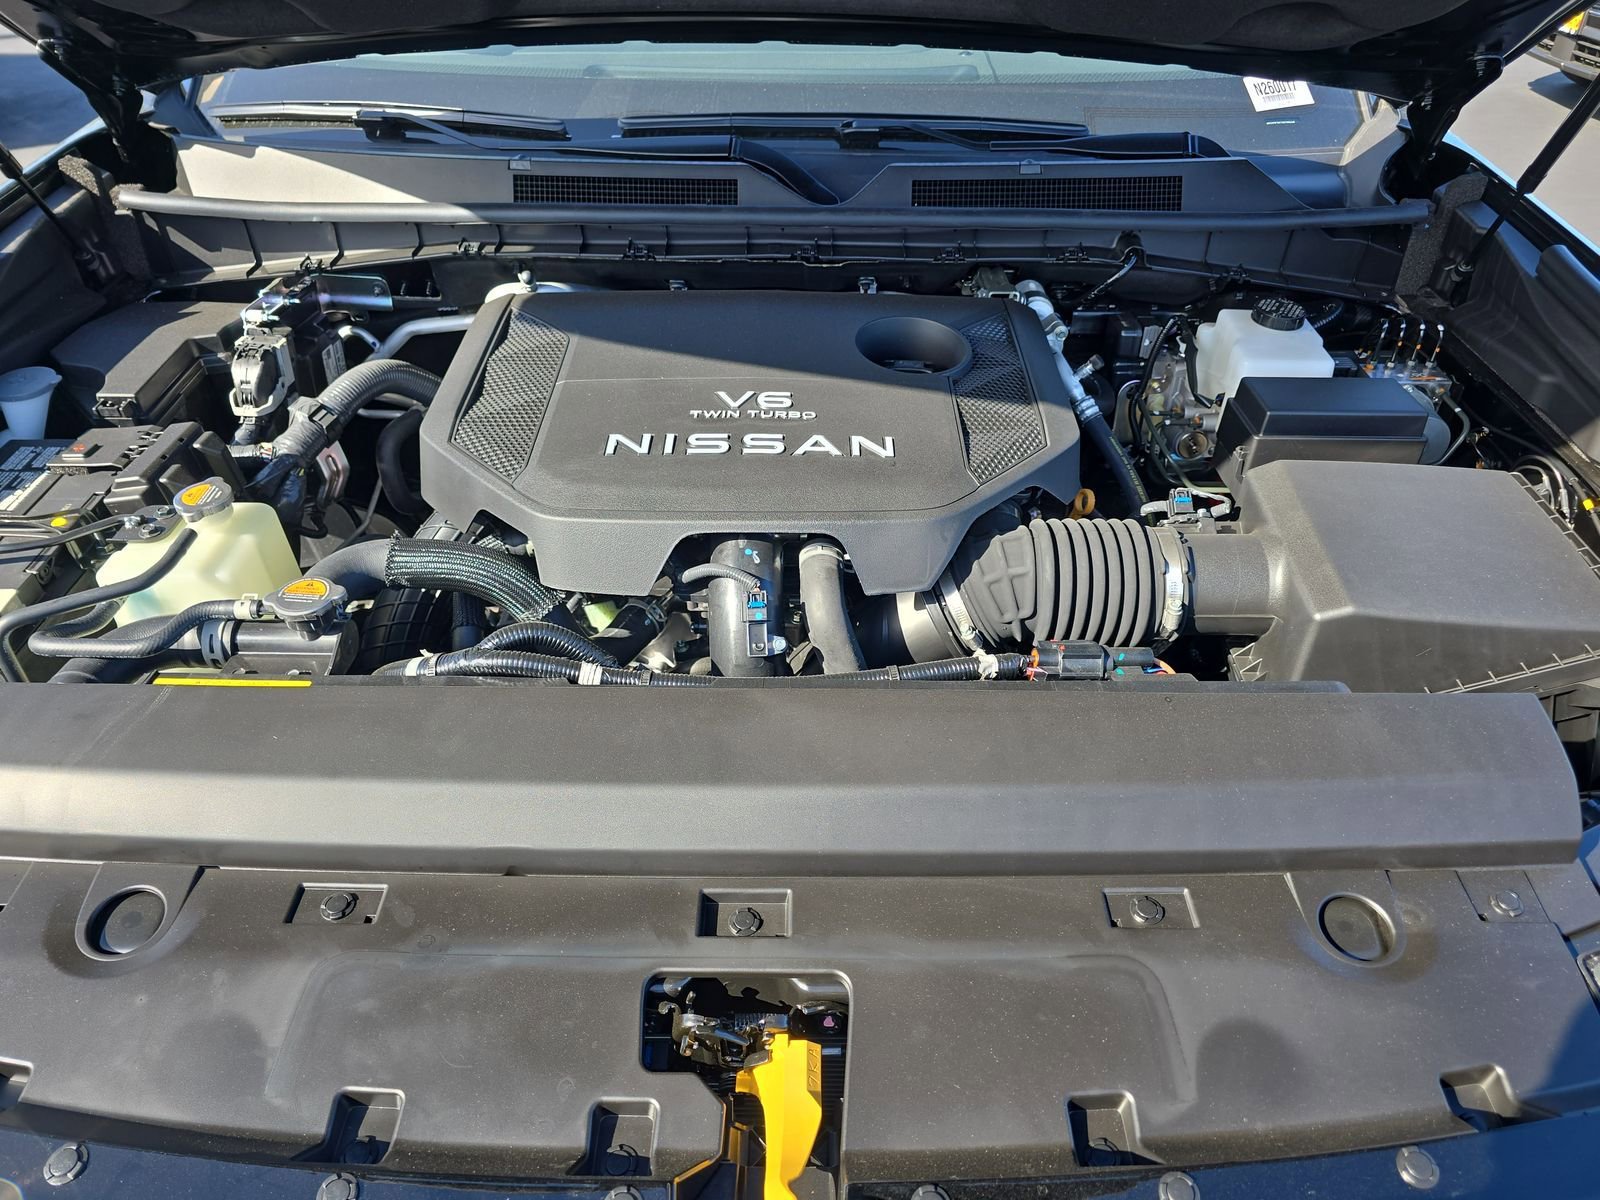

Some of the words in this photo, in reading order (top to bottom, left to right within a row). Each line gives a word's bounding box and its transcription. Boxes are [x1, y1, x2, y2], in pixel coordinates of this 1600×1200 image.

[714, 390, 794, 410] V6
[689, 409, 741, 419] TWIN
[746, 409, 818, 420] TURBO
[604, 433, 897, 459] NISSAN
